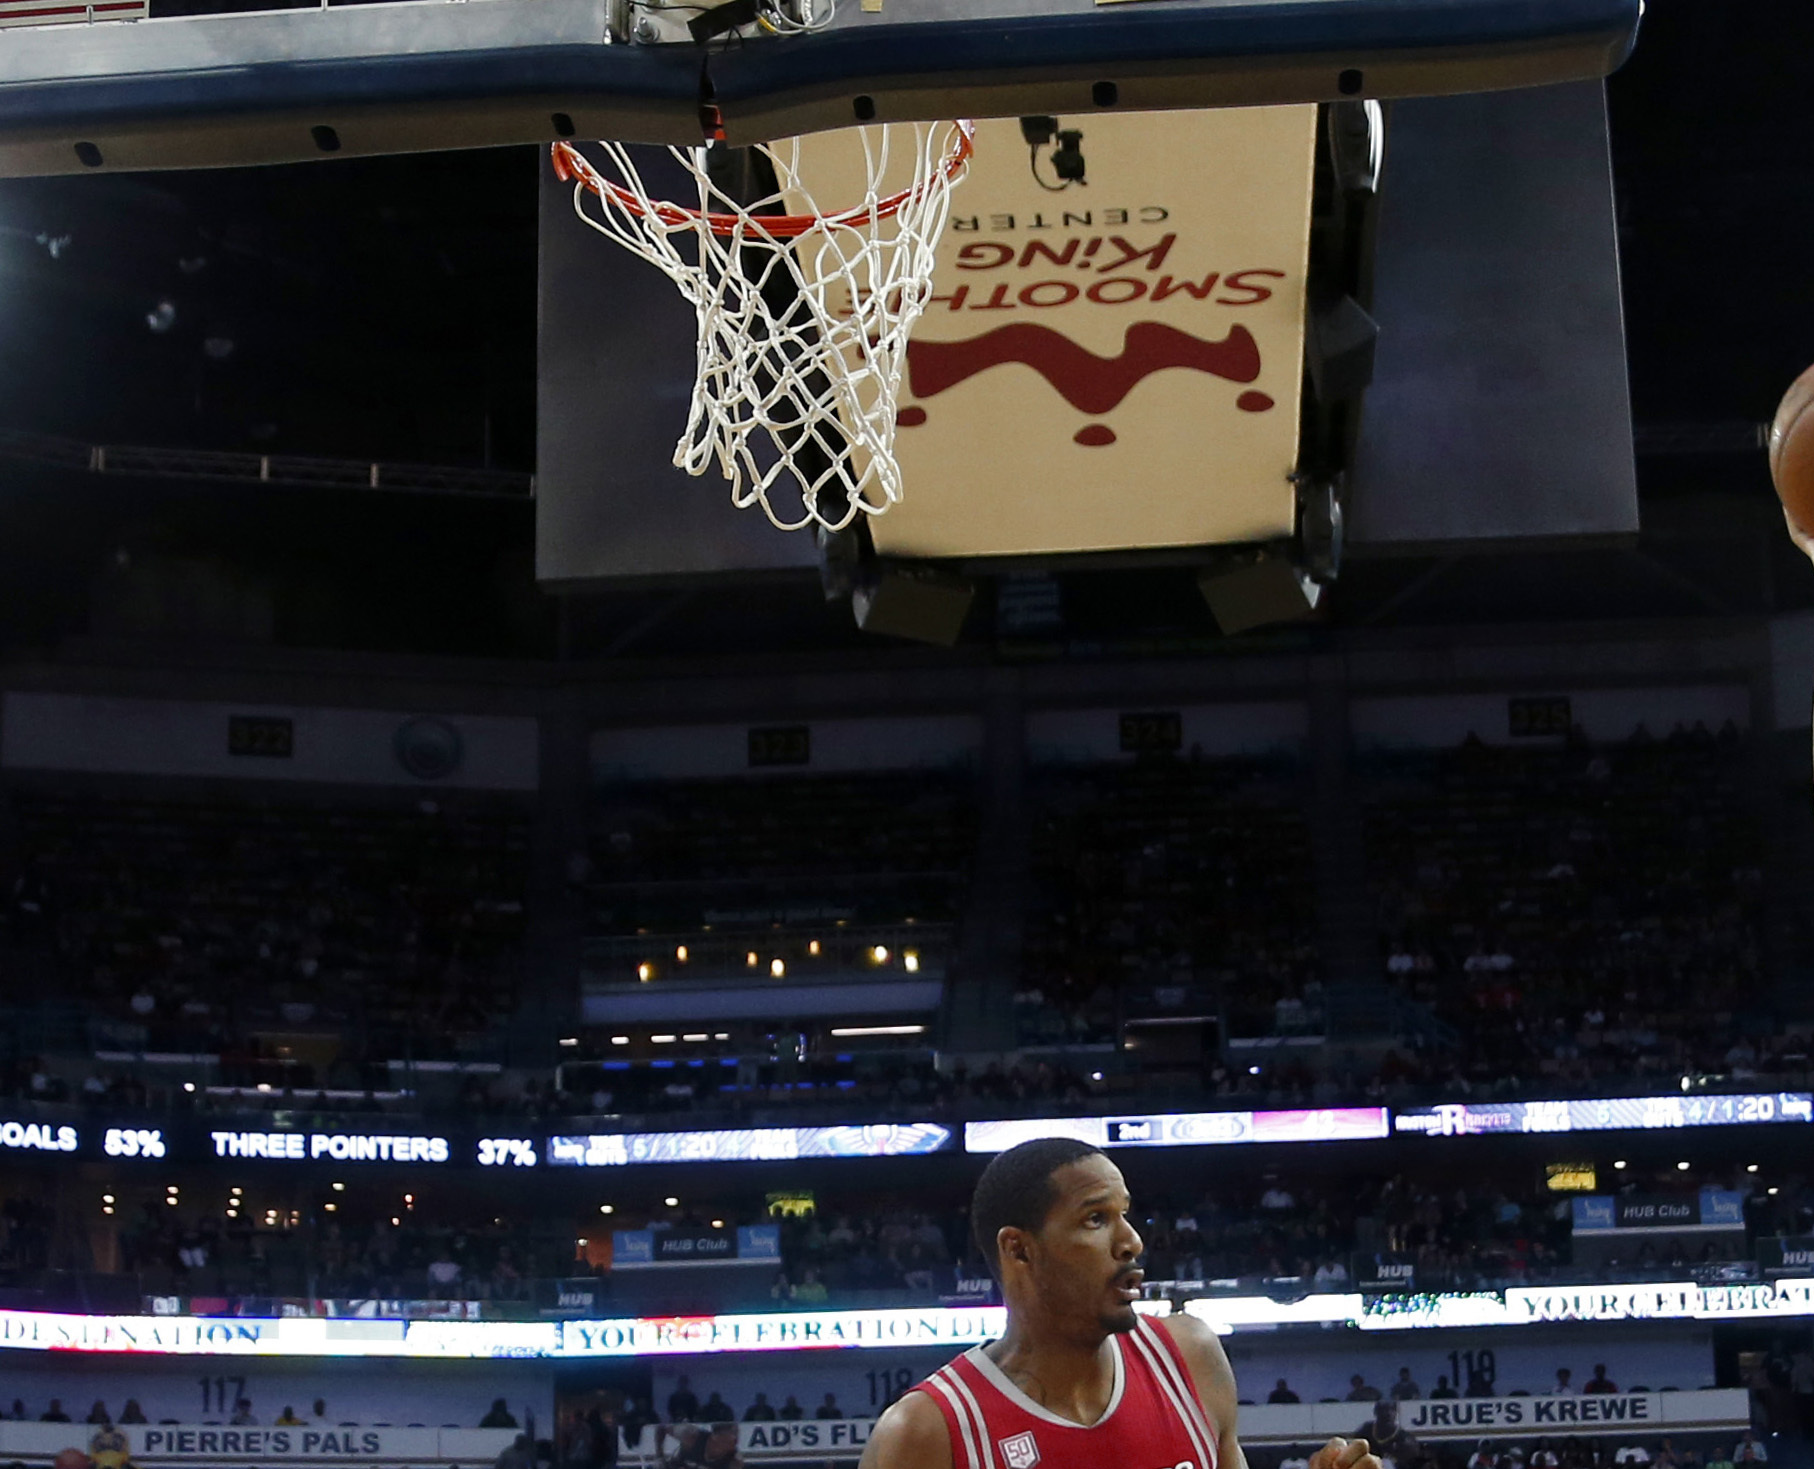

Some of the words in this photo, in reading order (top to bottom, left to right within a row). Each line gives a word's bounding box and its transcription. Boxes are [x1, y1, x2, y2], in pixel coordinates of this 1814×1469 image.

[952, 207, 1170, 232] CENTER
[838, 269, 1287, 315] SMOOTHE
[0, 1122, 78, 1152] OALS
[104, 1128, 165, 1158] 53%
[211, 1131, 305, 1159] THREE
[310, 1133, 449, 1163] POINTERS
[477, 1138, 537, 1167] 37%
[1624, 1205, 1655, 1218] HUB
[1658, 1204, 1690, 1217] Club
[662, 1237, 693, 1252] HUB
[697, 1236, 729, 1250] Club
[199, 1375, 245, 1413] 117
[1412, 1402, 1523, 1426] JRUE'S
[1534, 1397, 1649, 1422] KREWE
[144, 1430, 291, 1453] PIERRE'S
[302, 1431, 380, 1454] PALS
[748, 1424, 820, 1448] AD'S
[830, 1422, 876, 1446] FL
[1007, 1439, 1030, 1460] 50
